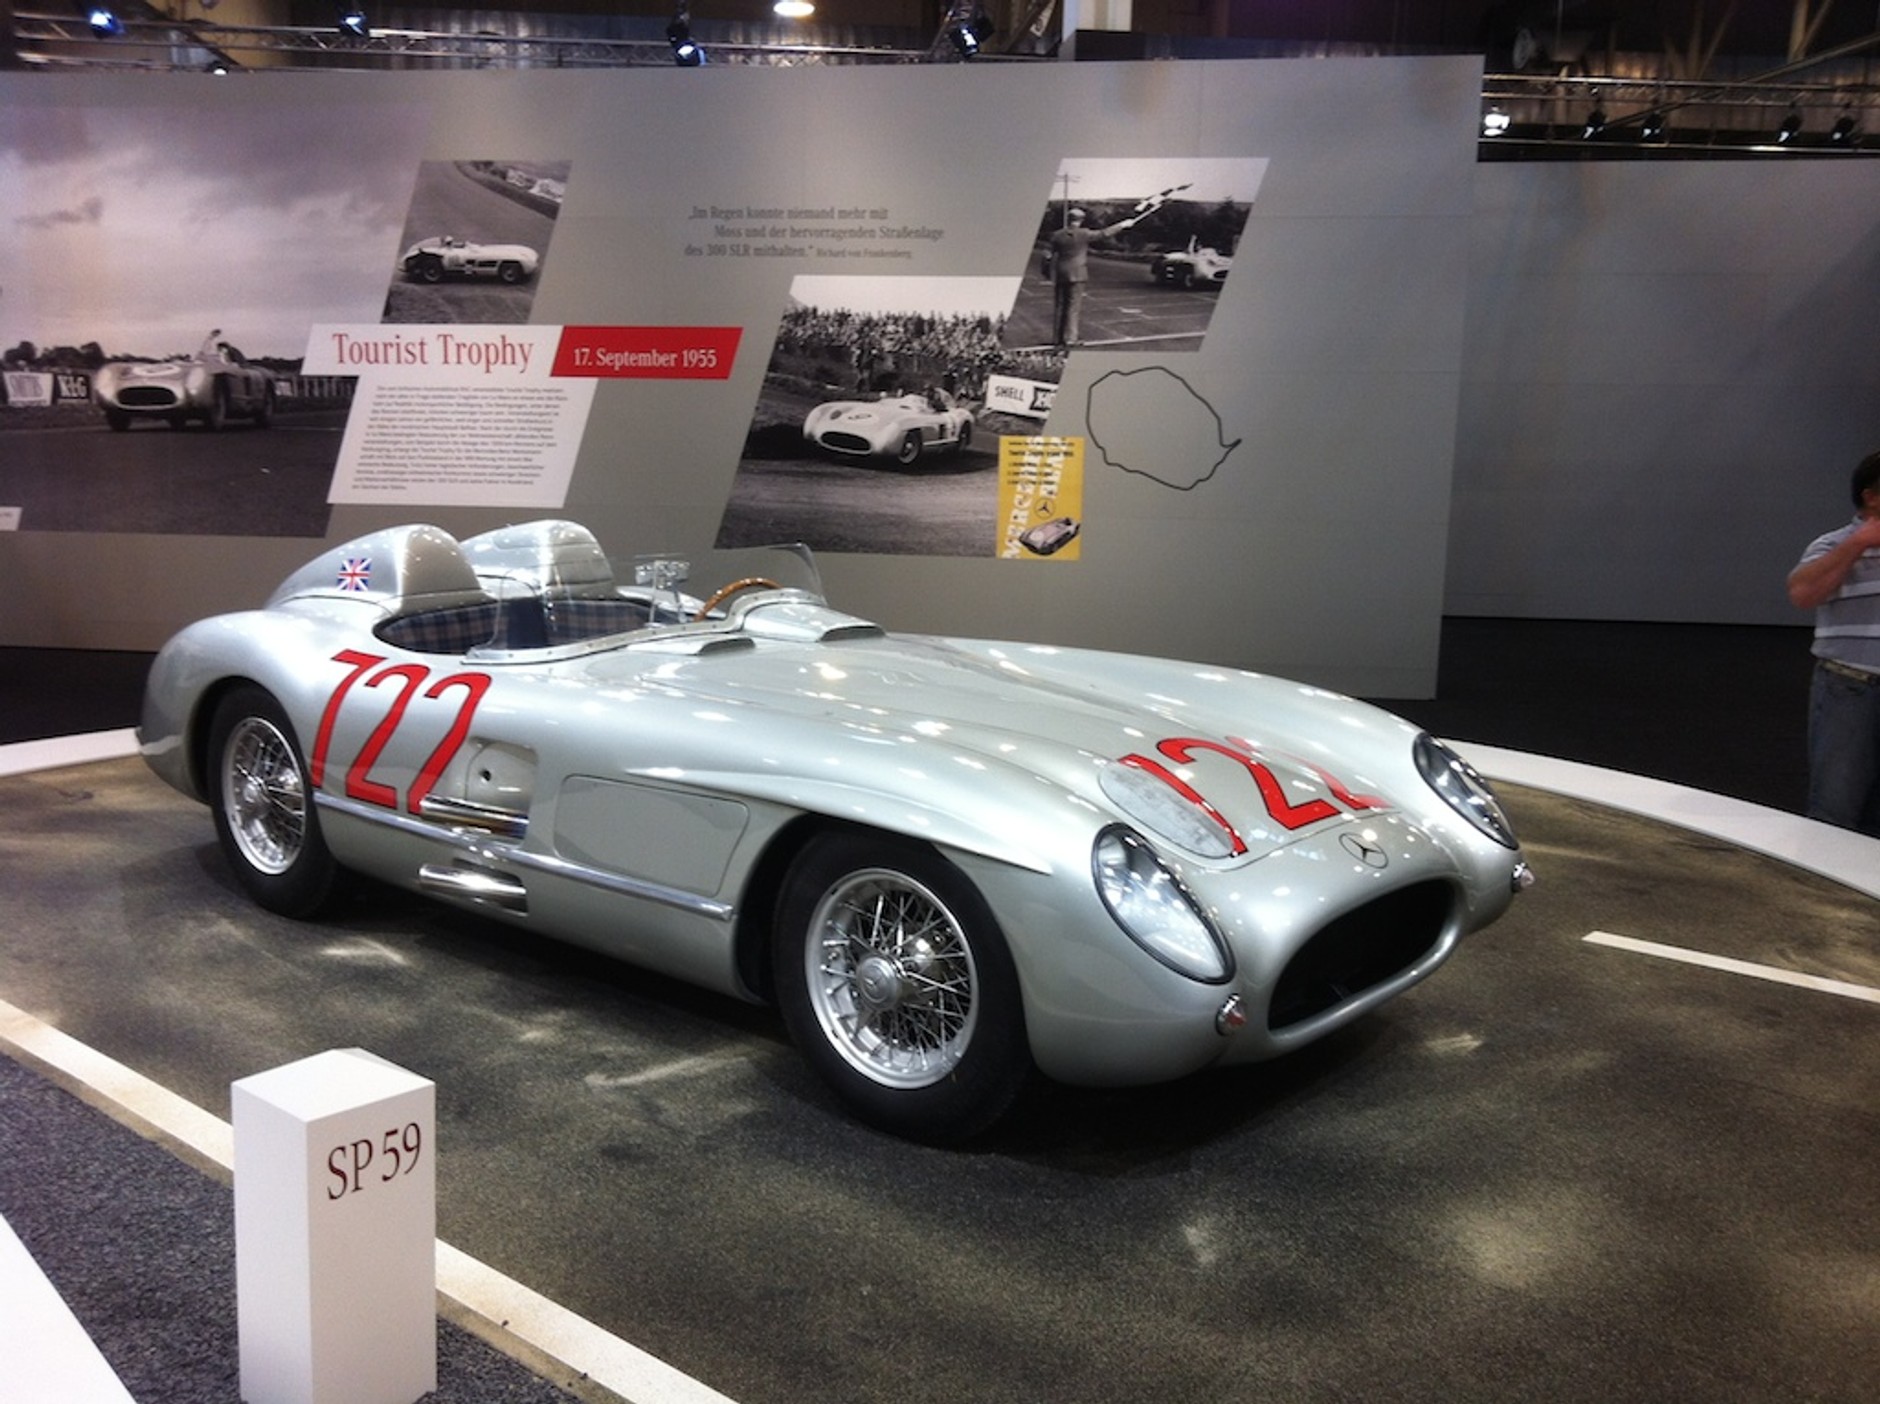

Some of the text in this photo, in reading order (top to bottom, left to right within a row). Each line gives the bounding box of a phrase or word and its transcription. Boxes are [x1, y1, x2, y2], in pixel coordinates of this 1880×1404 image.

[710, 206, 743, 221] Regen
[746, 206, 784, 219] konnte
[787, 206, 834, 219] niemand
[837, 206, 866, 219] mehr
[869, 206, 888, 219] mit
[714, 225, 945, 242] Moss und der hervorragenden Straßenlage
[684, 244, 703, 256] des
[706, 244, 727, 256] 300
[729, 244, 750, 256] SLR
[332, 333, 534, 373] Tourist Trophy
[574, 348, 717, 372] 17. September 1955
[994, 385, 1024, 402] SHELL
[310, 649, 493, 815] 722
[327, 1122, 421, 1201] SP 59
